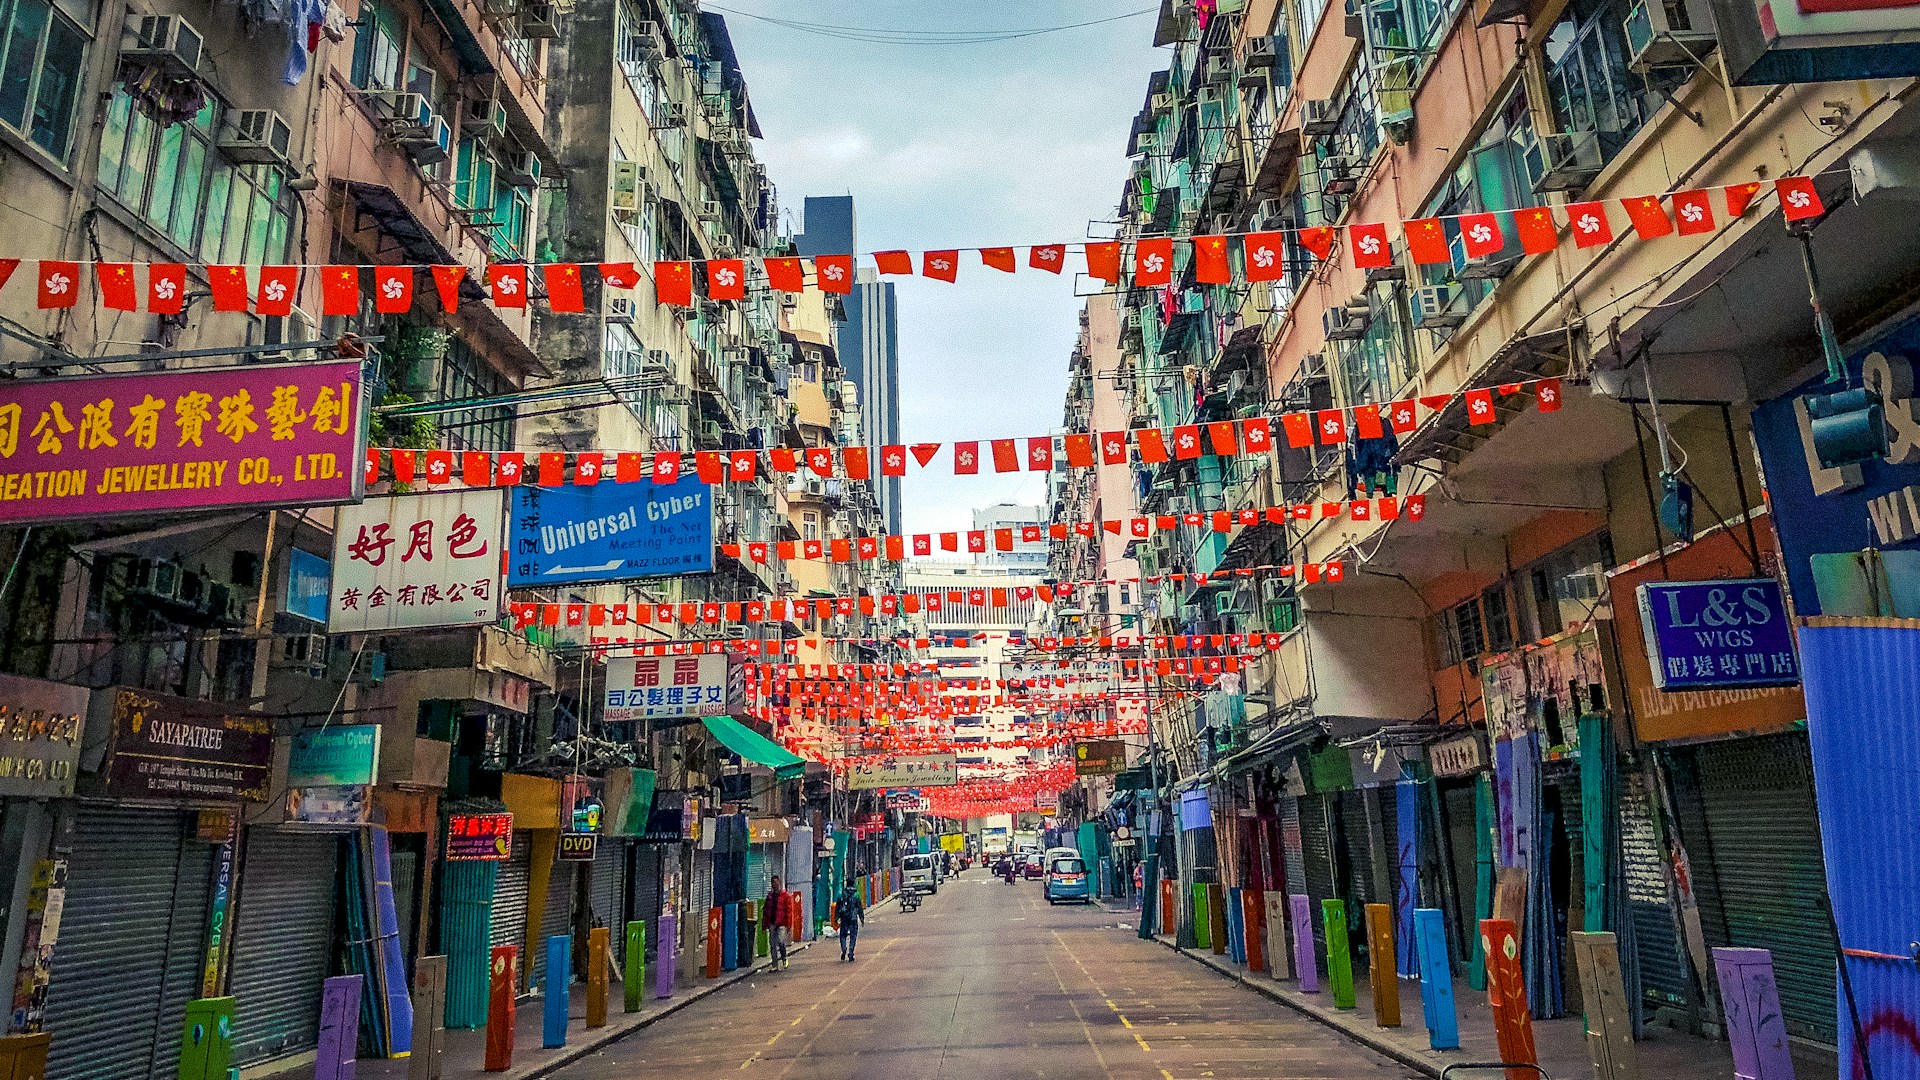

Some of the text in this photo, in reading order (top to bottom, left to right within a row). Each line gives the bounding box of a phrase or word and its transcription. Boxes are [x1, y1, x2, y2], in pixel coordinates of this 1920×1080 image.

[97, 460, 228, 494] JEWELLERY
[238, 457, 283, 486] CO.,
[294, 453, 343, 480] LTD.
[541, 493, 702, 554] Universal Cyber
[651, 524, 674, 535] The
[347, 512, 488, 567] 好月色
[609, 535, 702, 551] Meeting Point
[627, 559, 649, 568] MAZZ
[652, 557, 680, 567] FLOOR
[473, 609, 487, 617] 197
[1662, 587, 1771, 628] L&S
[1695, 629, 1754, 648] WIGS
[634, 658, 699, 687] 晶晶
[605, 708, 632, 720] MASSAGE
[699, 704, 727, 716] MASSAGE
[149, 719, 224, 750] SAYAPATREE
[855, 774, 951, 785] Jade Forever Jewellery
[563, 837, 592, 850] DVD
